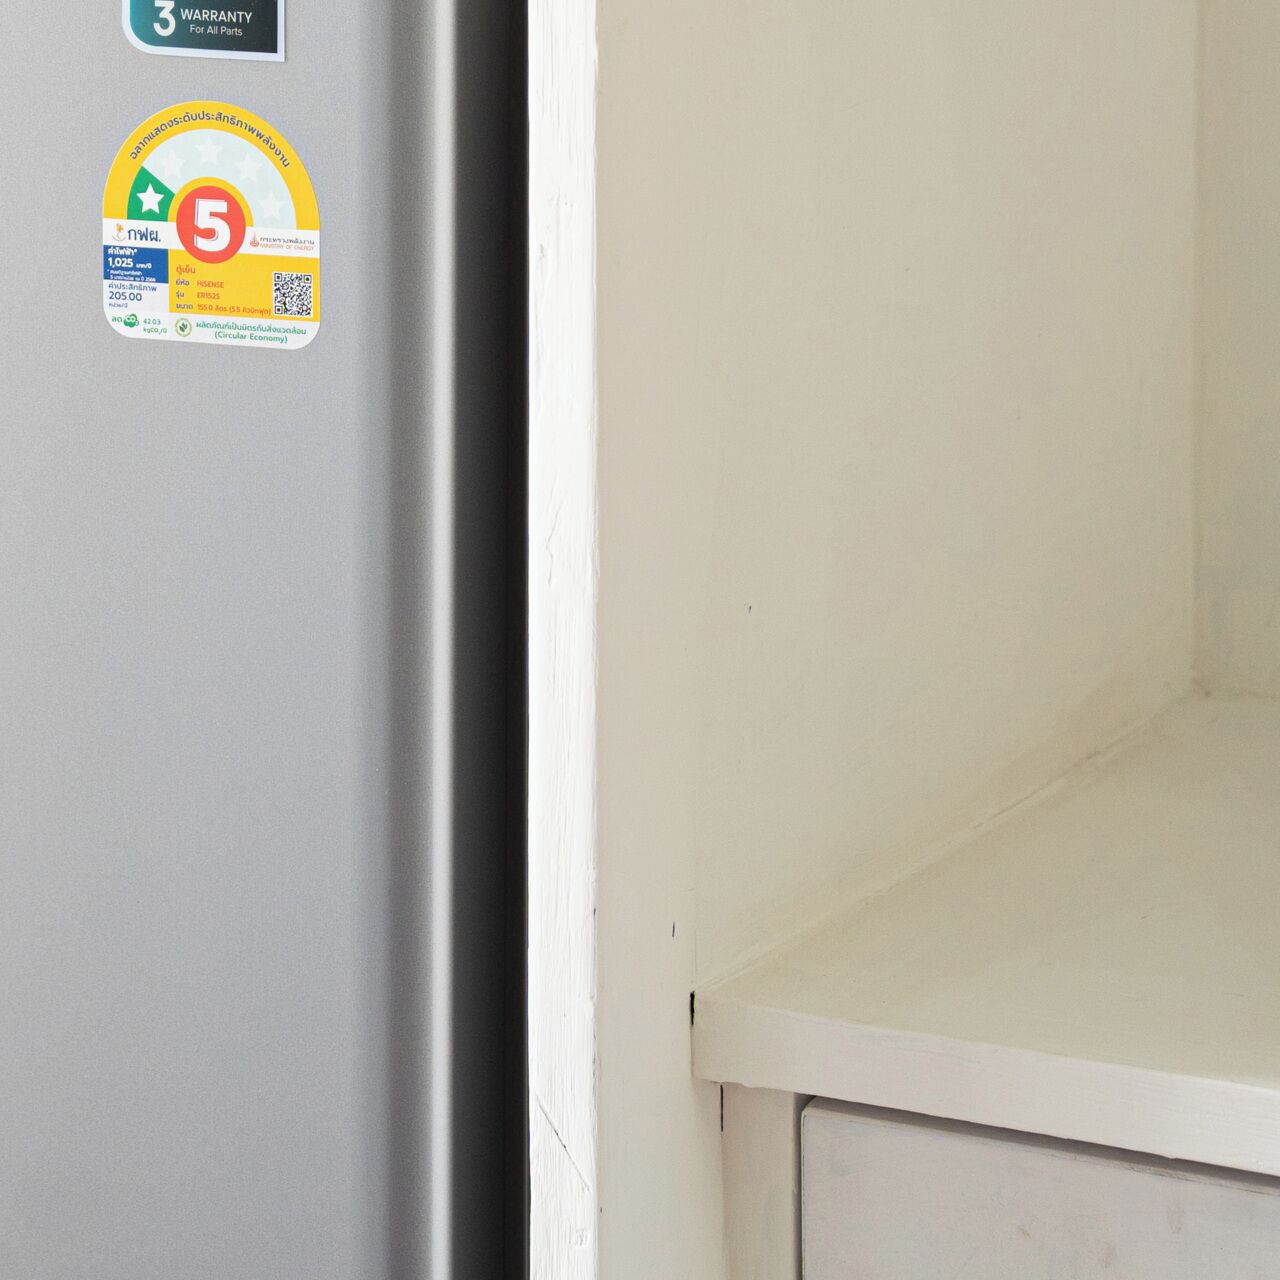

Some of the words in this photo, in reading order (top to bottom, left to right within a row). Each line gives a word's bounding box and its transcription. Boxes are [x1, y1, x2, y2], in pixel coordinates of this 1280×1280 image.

[153, 0, 176, 37] 3
[181, 8, 252, 23] WARRANTY
[190, 24, 205, 34] For
[206, 24, 219, 35] All
[220, 25, 243, 36] Parts
[193, 198, 231, 252] 5
[128, 225, 161, 242] กฟผ.
[108, 257, 133, 268] 1,025
[109, 291, 142, 301] 205.00
[215, 332, 247, 340] (Circular
[250, 333, 288, 343] Economy)
